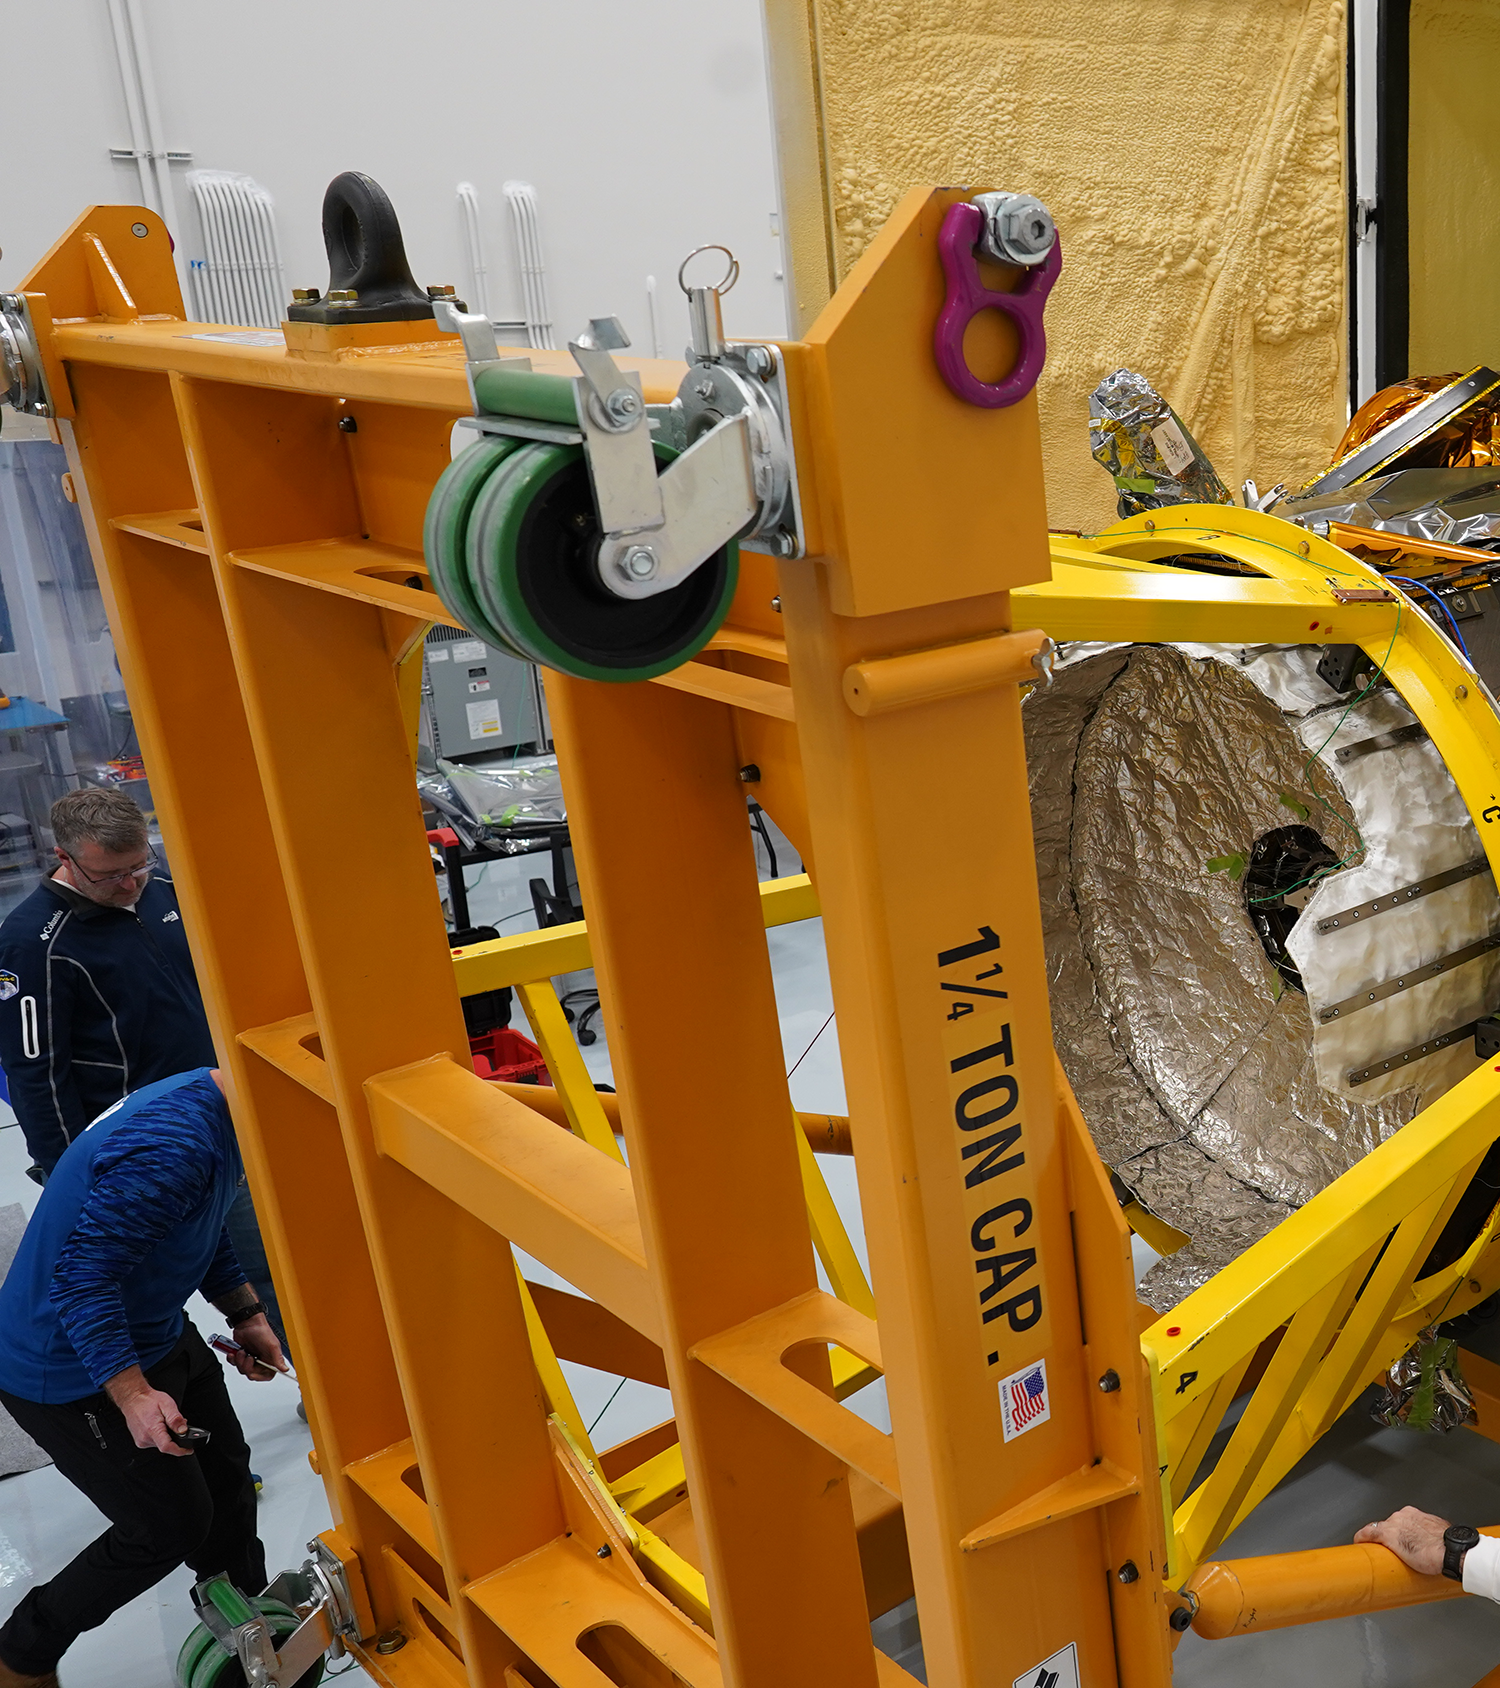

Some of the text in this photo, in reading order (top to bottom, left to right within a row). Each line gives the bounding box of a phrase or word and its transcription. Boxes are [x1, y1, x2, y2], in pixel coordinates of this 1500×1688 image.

[43, 909, 64, 935] Columbia
[950, 1022, 1026, 1190] TON
[970, 1197, 1044, 1367] CAP.
[1175, 1370, 1198, 1395] 4
